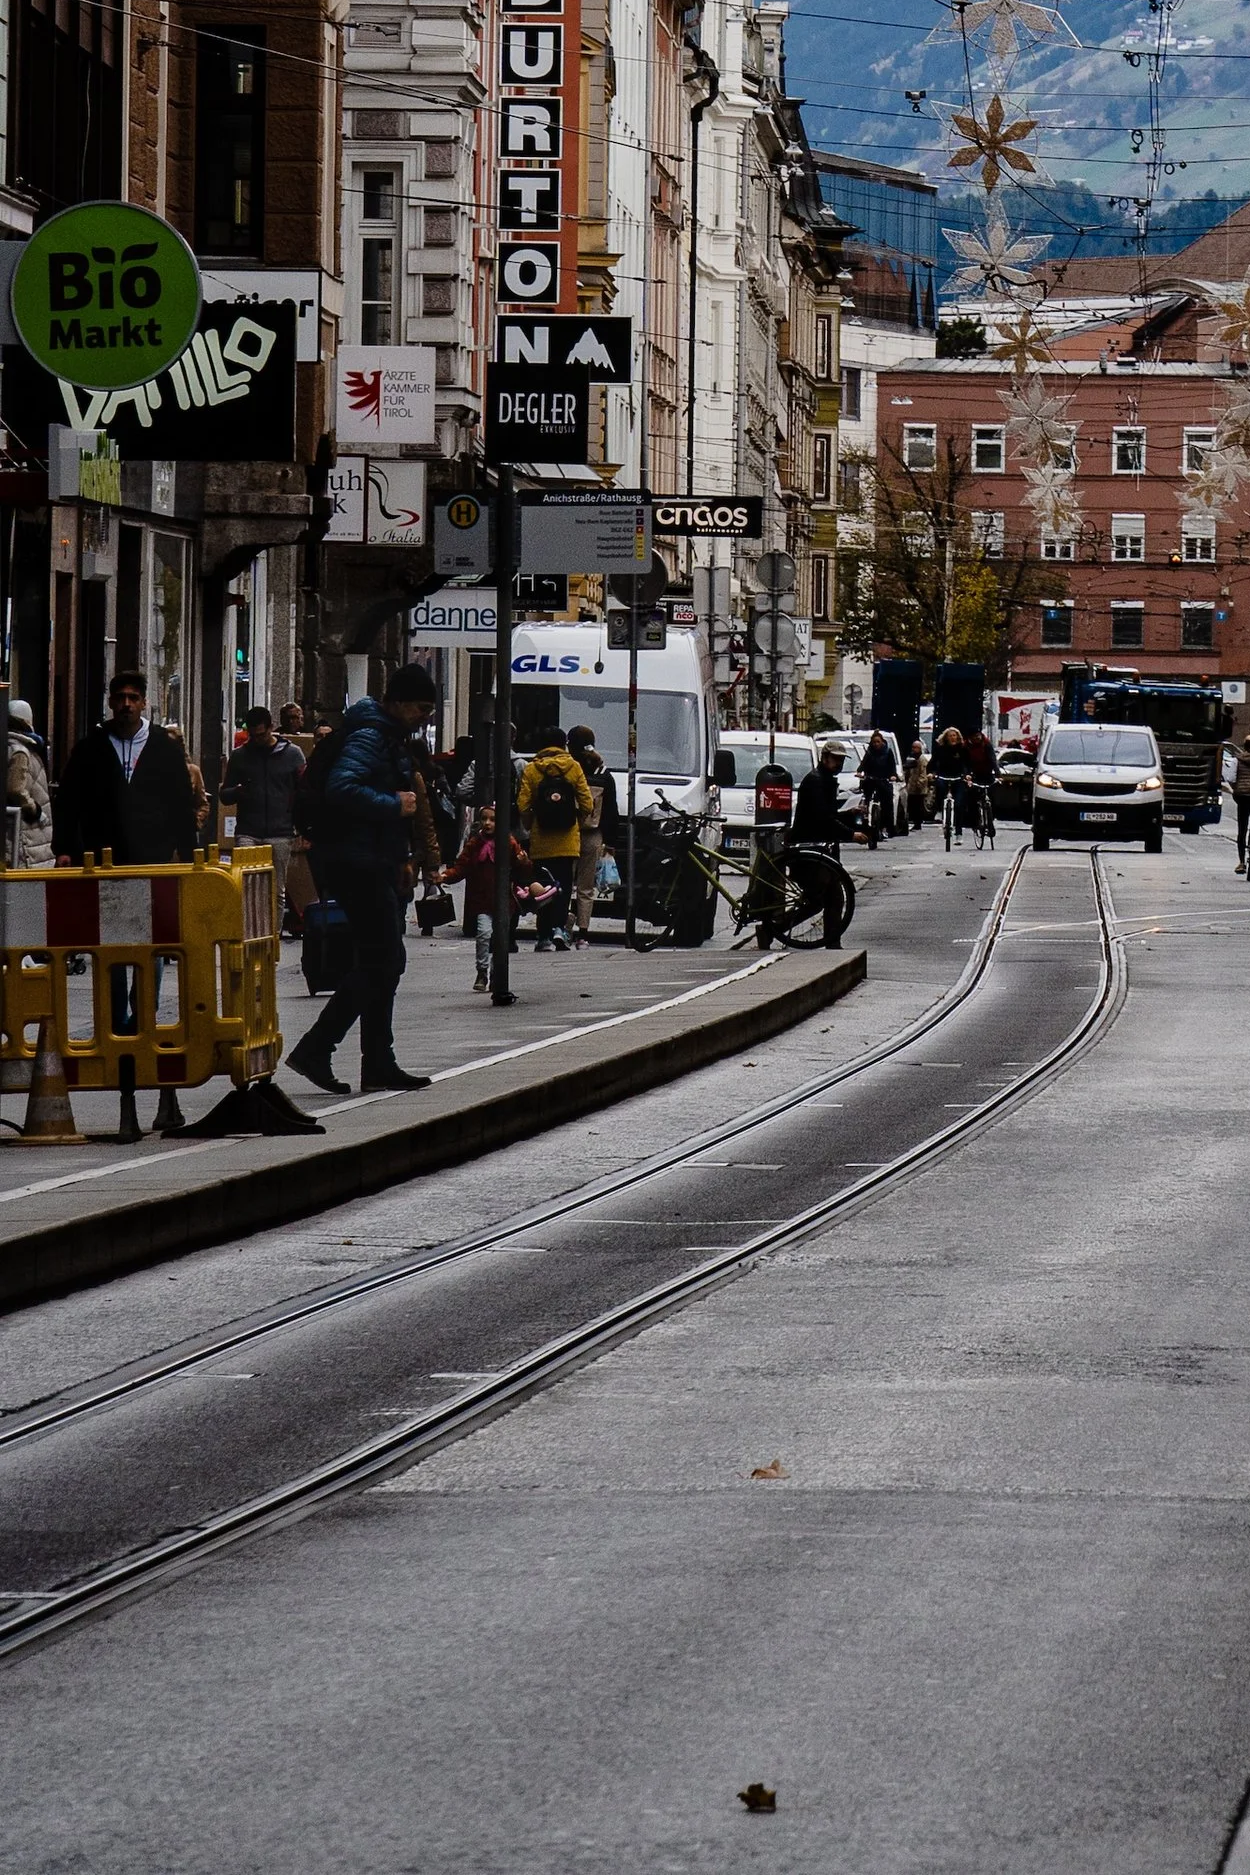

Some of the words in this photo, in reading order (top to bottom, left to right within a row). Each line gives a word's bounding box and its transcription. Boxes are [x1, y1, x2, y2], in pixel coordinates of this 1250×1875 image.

[48, 242, 162, 312] Bio
[49, 316, 163, 351] Markt
[383, 369, 416, 381] ÄRZTE
[383, 383, 431, 393] KAMMER
[383, 407, 413, 418] TIROL
[498, 392, 577, 424] DEGLER
[543, 493, 645, 504] Anichstraße/Rathausg.
[456, 505, 471, 522] H
[381, 529, 422, 544] Italia
